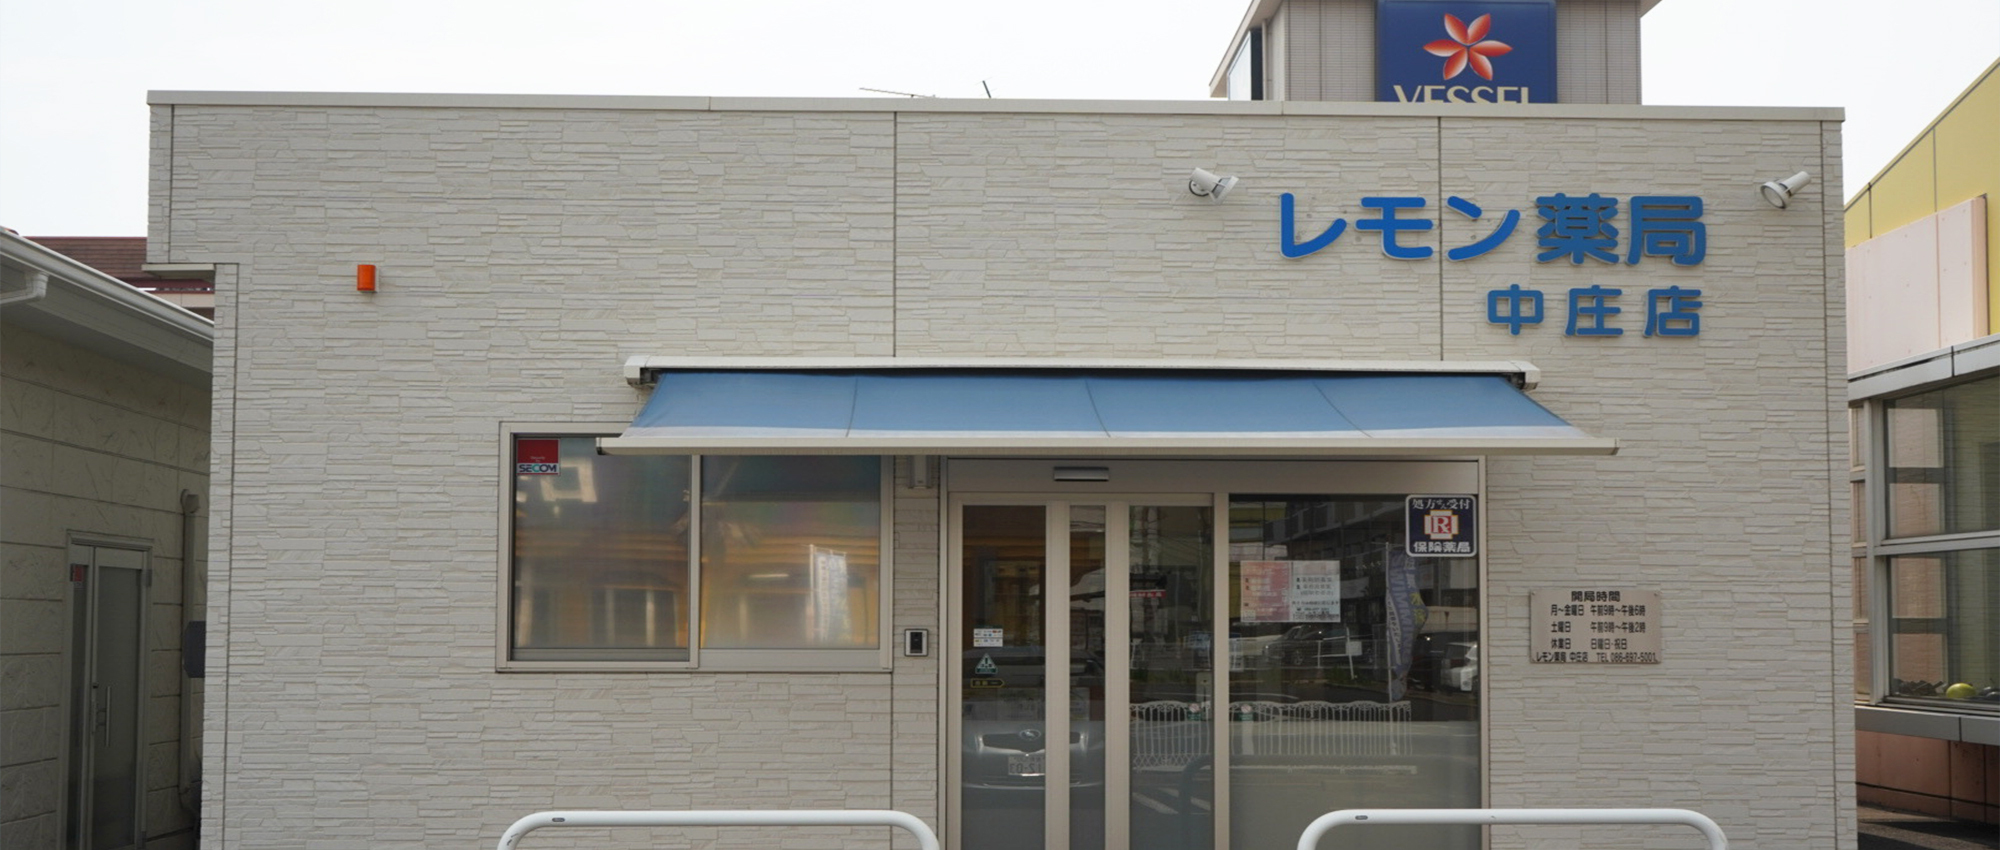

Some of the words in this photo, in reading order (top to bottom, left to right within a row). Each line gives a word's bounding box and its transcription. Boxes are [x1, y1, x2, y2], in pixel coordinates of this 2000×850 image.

[1279, 192, 1708, 266] レモン薬局
[1486, 283, 1704, 337] 中庄店
[519, 464, 557, 472] SECOM
[1413, 541, 1471, 553] 保険薬局
[1571, 591, 1621, 602] 開局時間
[1551, 621, 1571, 633] 土曜日
[1551, 638, 1571, 650] 休業日
[1597, 652, 1609, 662] TEL
